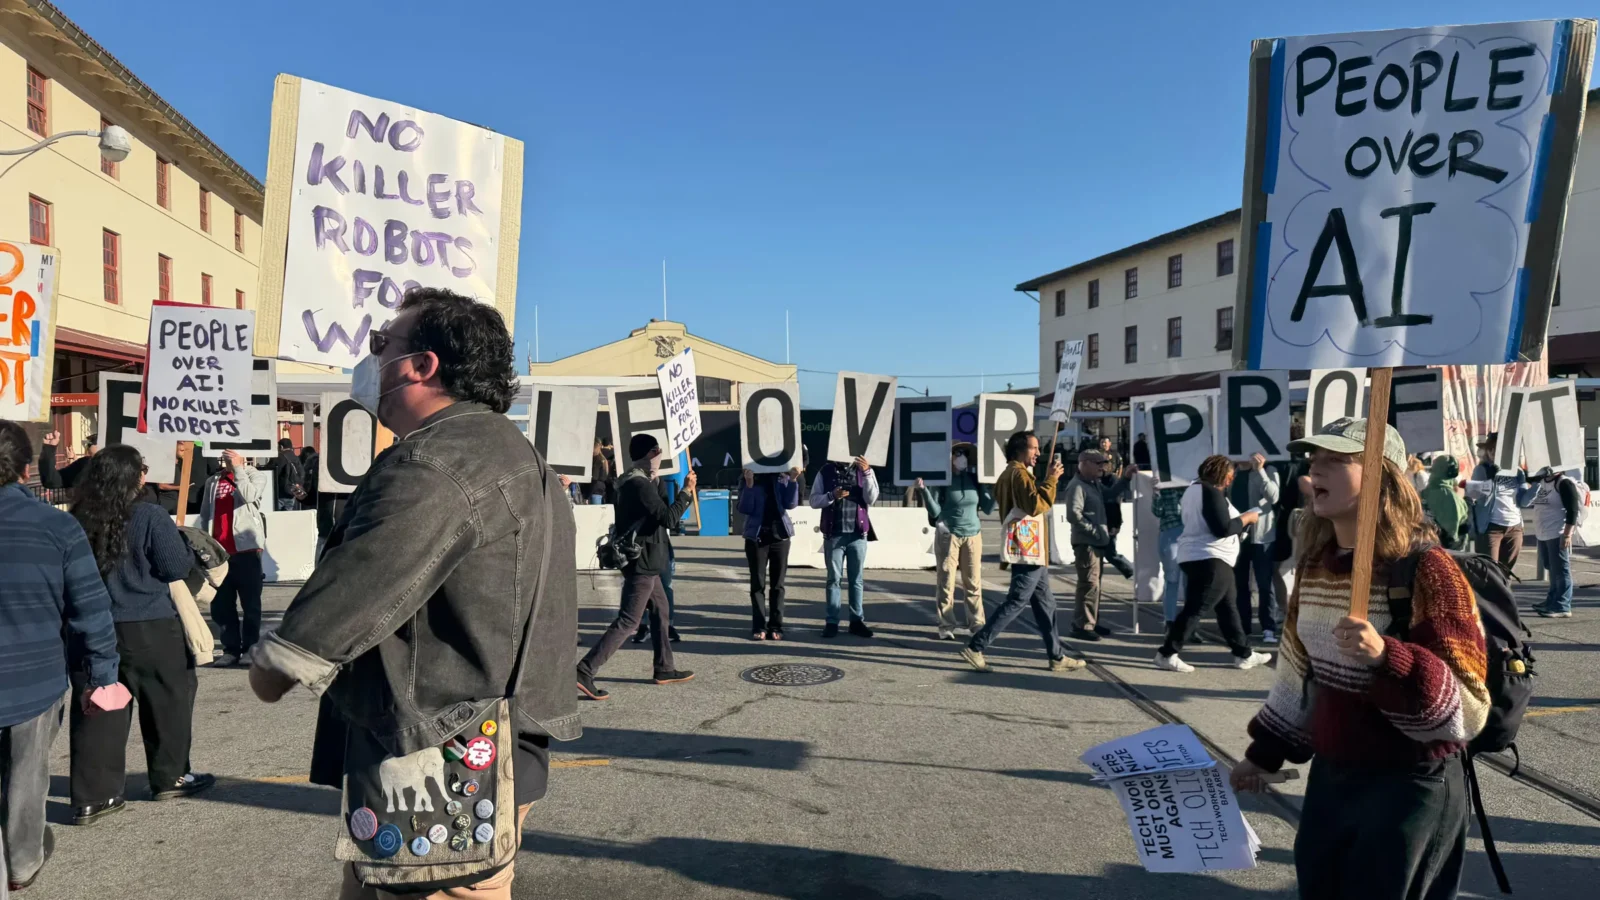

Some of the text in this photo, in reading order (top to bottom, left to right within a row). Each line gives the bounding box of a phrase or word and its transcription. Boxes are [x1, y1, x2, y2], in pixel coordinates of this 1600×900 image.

[1295, 42, 1537, 117] PEOPLE
[346, 109, 424, 152] NO
[306, 142, 484, 219] KILLER
[312, 205, 477, 278] ROBOTS
[1290, 202, 1437, 328] AI
[159, 319, 248, 351] PEOPLE
[172, 356, 222, 371] OVER
[669, 363, 683, 382] NO
[177, 374, 223, 392] AI!
[665, 377, 693, 408] KILLER
[153, 396, 243, 415] NO KILLER
[670, 388, 695, 419] ROBOTS
[678, 409, 692, 426] FOR
[159, 413, 240, 437] ROBOTS
[673, 416, 699, 450] ICE!
[1140, 775, 1161, 811] ORG
[1207, 777, 1223, 820] WORKERS
[1212, 768, 1229, 806] BAY AREA
[1135, 815, 1158, 856] TECH
[1151, 815, 1175, 859] MUST
[1189, 821, 1224, 867] TECH
[1216, 821, 1229, 843] TECH
